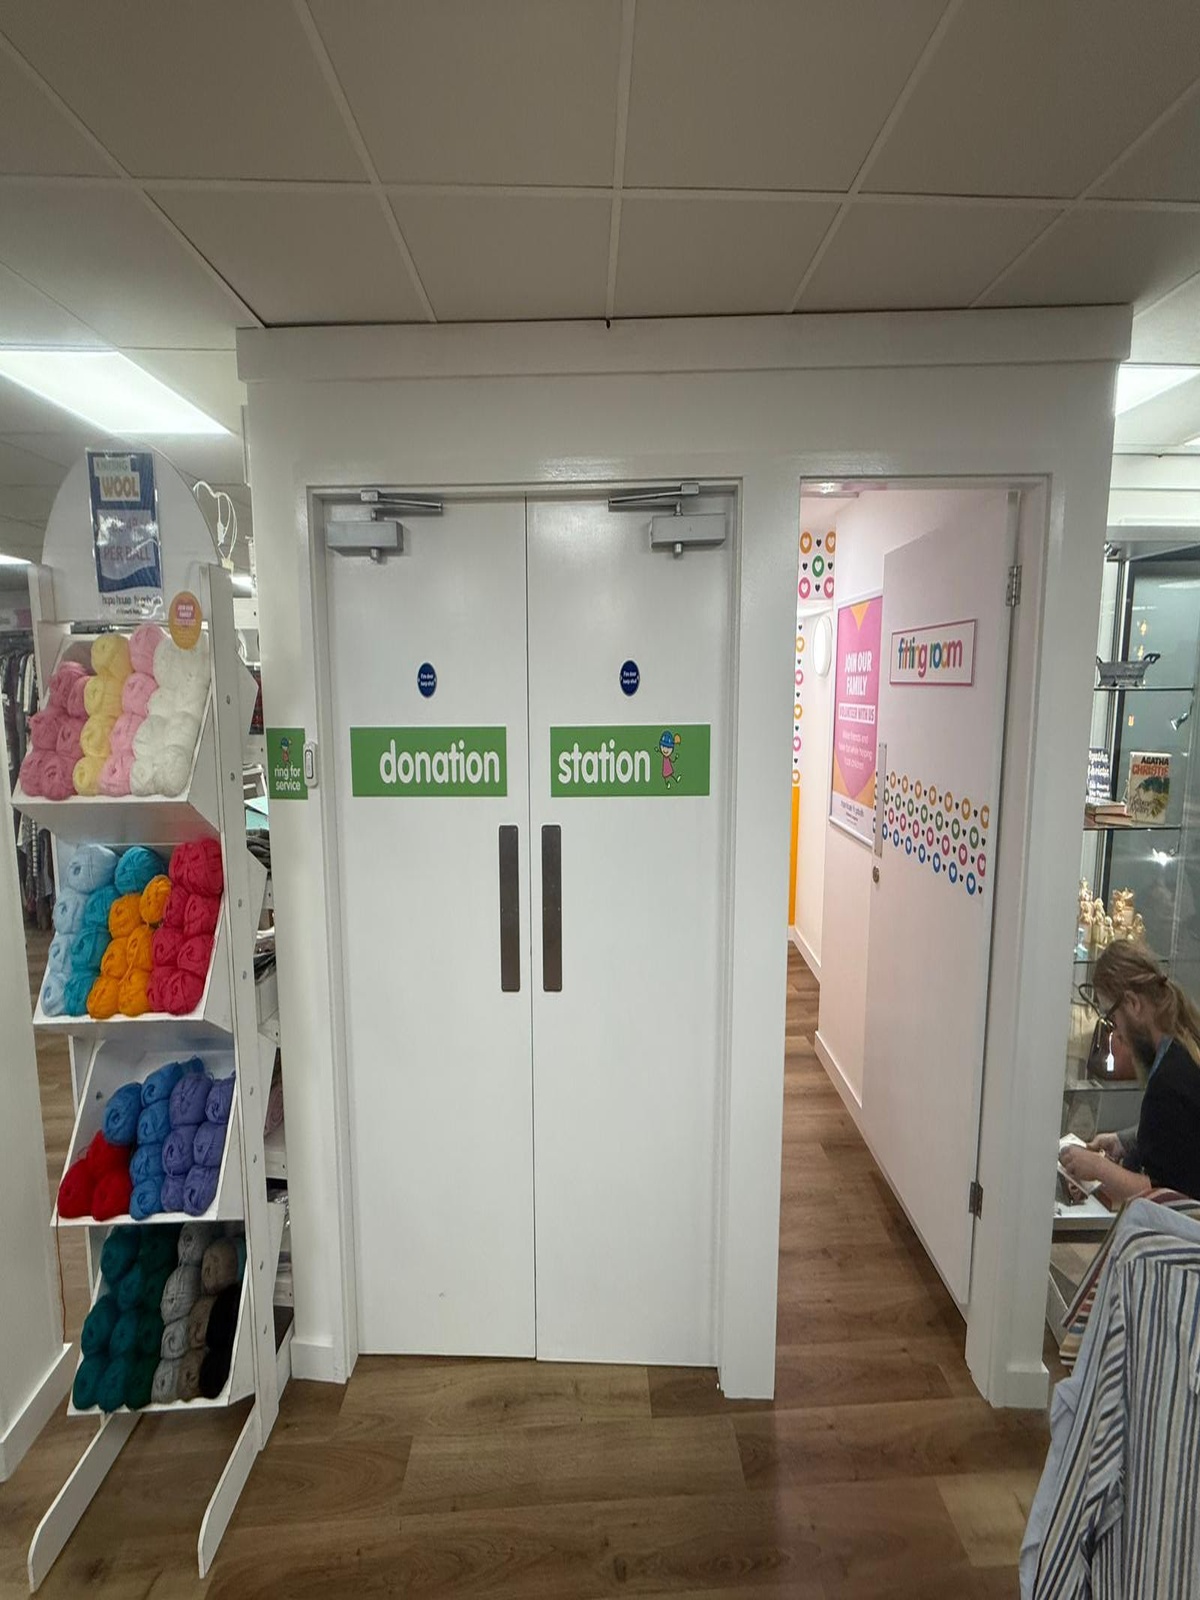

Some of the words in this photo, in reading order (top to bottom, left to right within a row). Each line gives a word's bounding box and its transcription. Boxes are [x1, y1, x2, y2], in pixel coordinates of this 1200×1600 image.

[101, 475, 139, 498] WOOL
[103, 546, 122, 560] PER
[125, 547, 152, 561] BALL
[845, 652, 857, 673] JOIN
[857, 650, 872, 672] OUR
[929, 639, 963, 669] room
[846, 675, 868, 696] FAMILY
[379, 739, 500, 784] donation
[558, 739, 650, 784] station
[1141, 755, 1170, 766] AGATHA
[274, 764, 289, 780] ring
[290, 765, 301, 778] for
[1132, 763, 1170, 777] CHRISTIE
[275, 779, 301, 791] service
